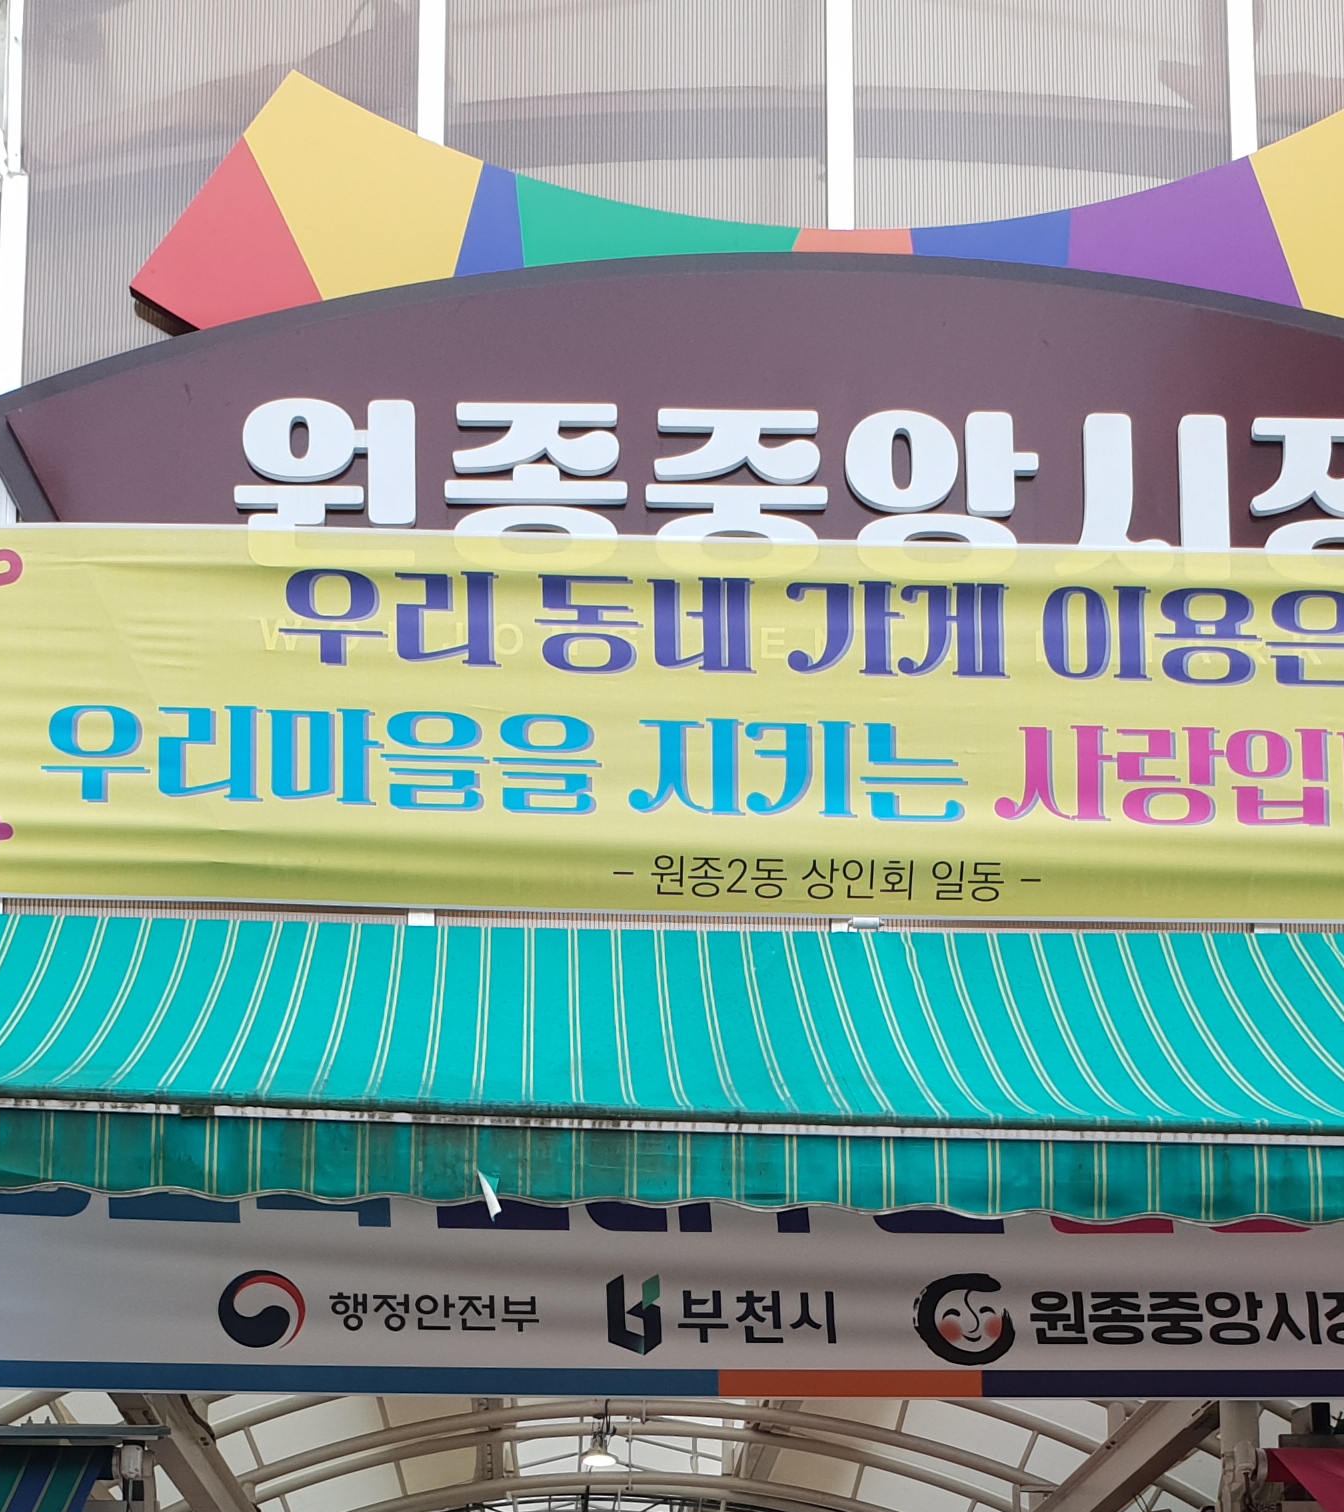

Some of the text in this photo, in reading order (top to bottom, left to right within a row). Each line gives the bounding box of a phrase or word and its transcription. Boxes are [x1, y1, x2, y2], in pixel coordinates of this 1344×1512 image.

[277, 568, 502, 668] 우리
[534, 573, 758, 675] 동네
[786, 580, 1011, 679] 가게
[40, 704, 603, 815] 우리마을을
[626, 717, 968, 823] 지키는
[650, 854, 1006, 903] 원종2동 상인회 일동
[328, 1290, 541, 1333] 행정안전부
[676, 1288, 838, 1345] 부천시
